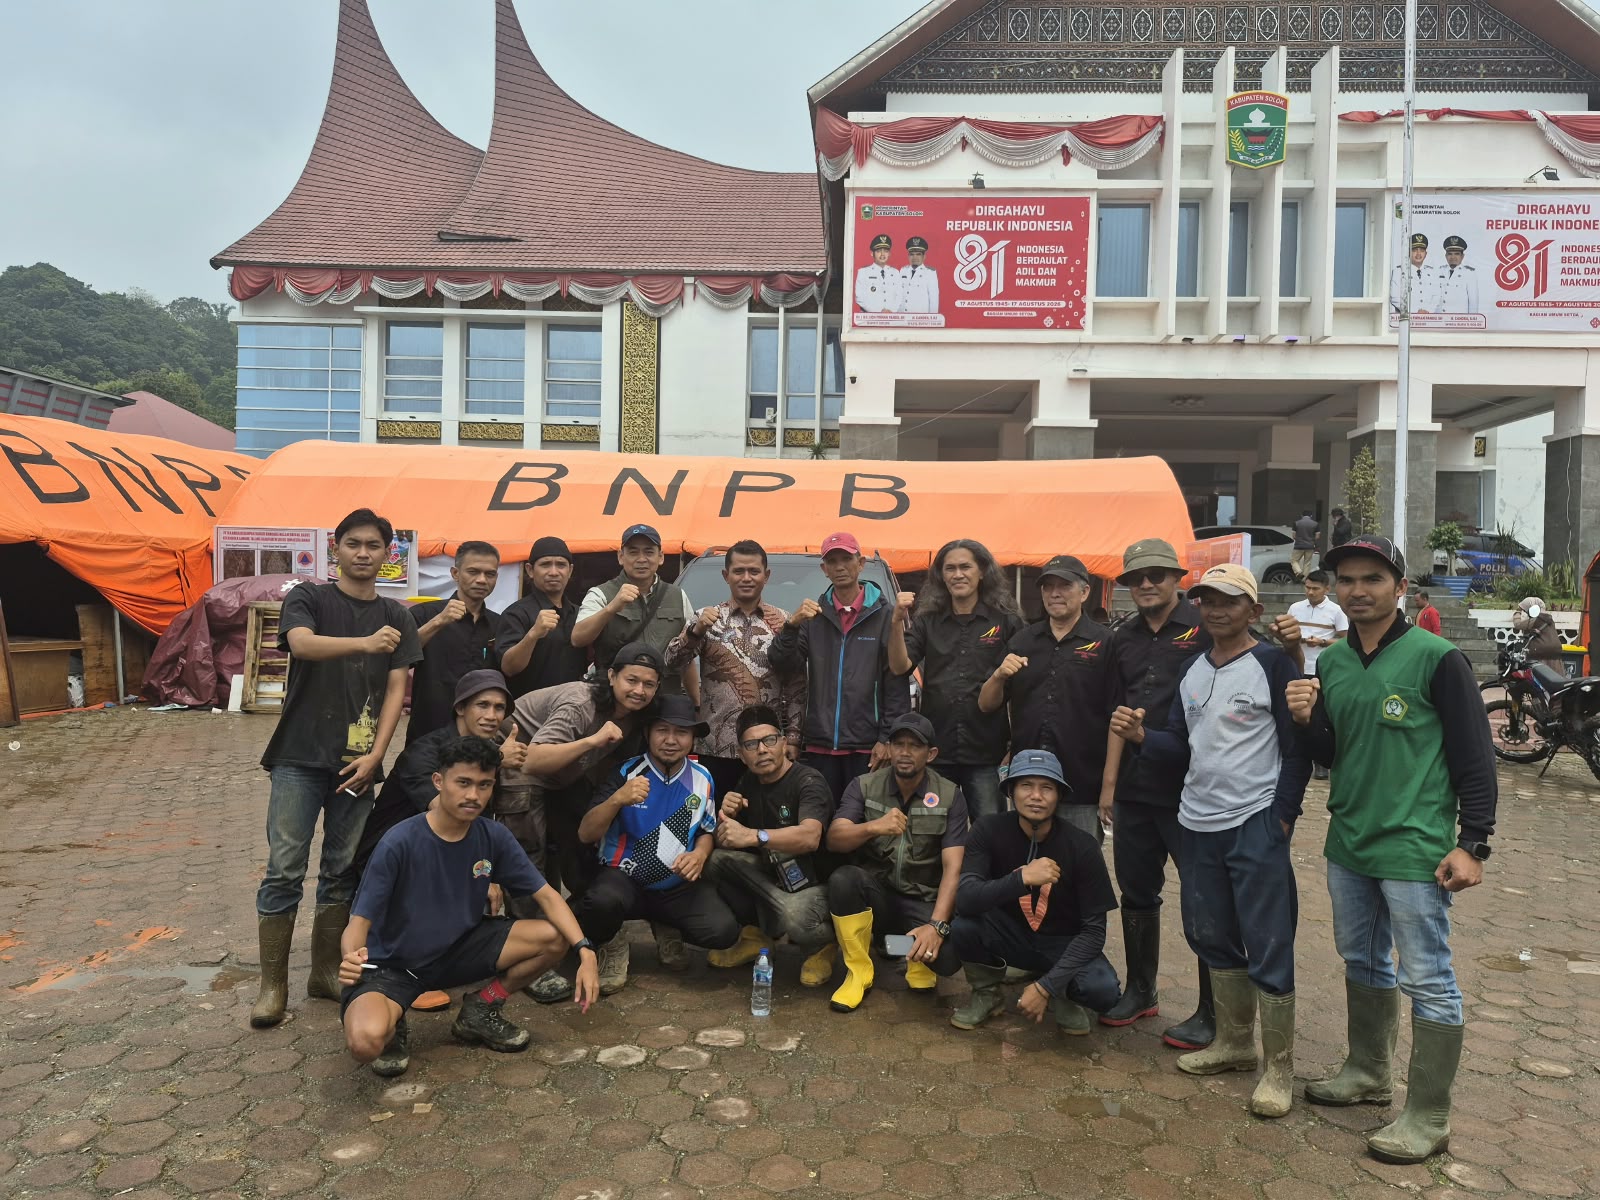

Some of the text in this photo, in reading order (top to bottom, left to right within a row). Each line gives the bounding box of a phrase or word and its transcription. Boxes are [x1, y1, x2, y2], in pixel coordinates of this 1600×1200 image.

[1230, 94, 1285, 106] KABUPATEN SOLOK
[975, 205, 1045, 217] DIRGAHAYU
[1517, 204, 1591, 215] DIRGAHAYU
[946, 220, 1073, 232] REPUBLIK INDONESIA
[1486, 219, 1548, 230] REPUBLIK
[1016, 245, 1065, 254] INDONESIA
[1016, 256, 1068, 265] BERDAULAT
[1561, 256, 1600, 264] BERDAU
[953, 233, 1011, 299] 81
[1015, 267, 1057, 276] ADIL DAN
[1494, 233, 1555, 299] 81
[1560, 267, 1582, 275] ADIL
[1015, 278, 1057, 287] MAKMUR
[0, 428, 251, 518] BNP
[487, 462, 911, 520] BNPB
[1479, 563, 1506, 572] POLIS
